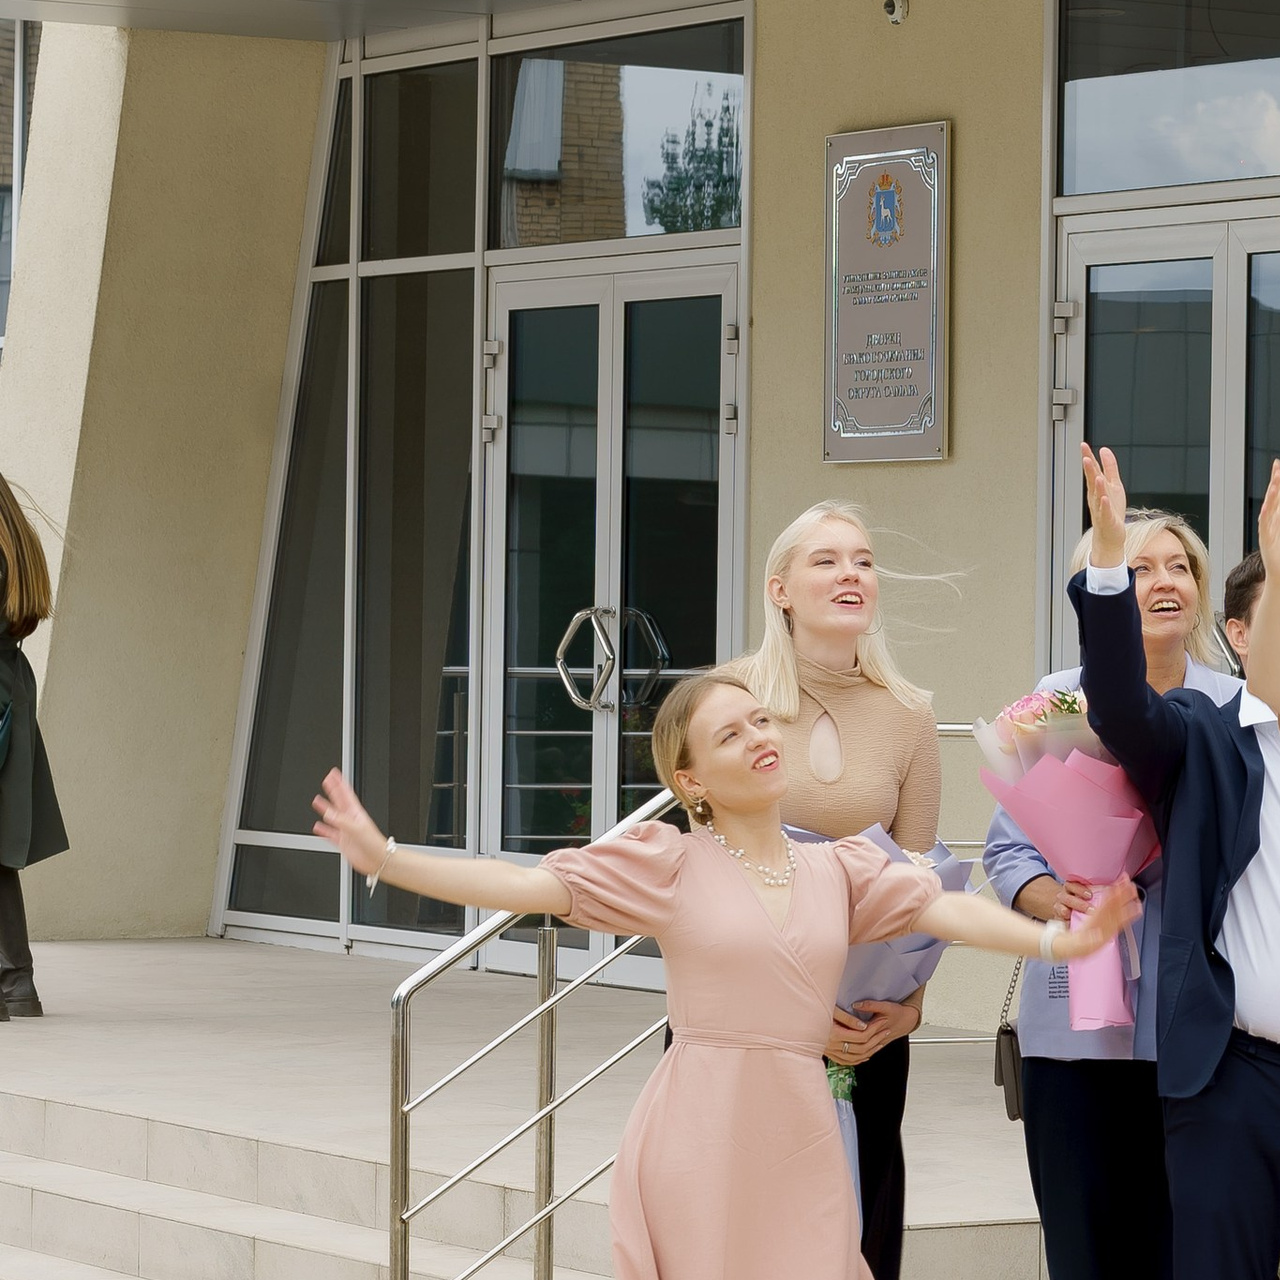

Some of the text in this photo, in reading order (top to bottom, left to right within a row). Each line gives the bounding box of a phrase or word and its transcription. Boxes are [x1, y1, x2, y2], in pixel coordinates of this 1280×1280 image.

[865, 332, 902, 349] ДВОРЕЦ
[842, 348, 925, 365] БРАКОСОЧЕТАНИЯ
[854, 366, 913, 384] ГОРОДСКОГО
[847, 384, 919, 400] ОКРУГА САМАРА
